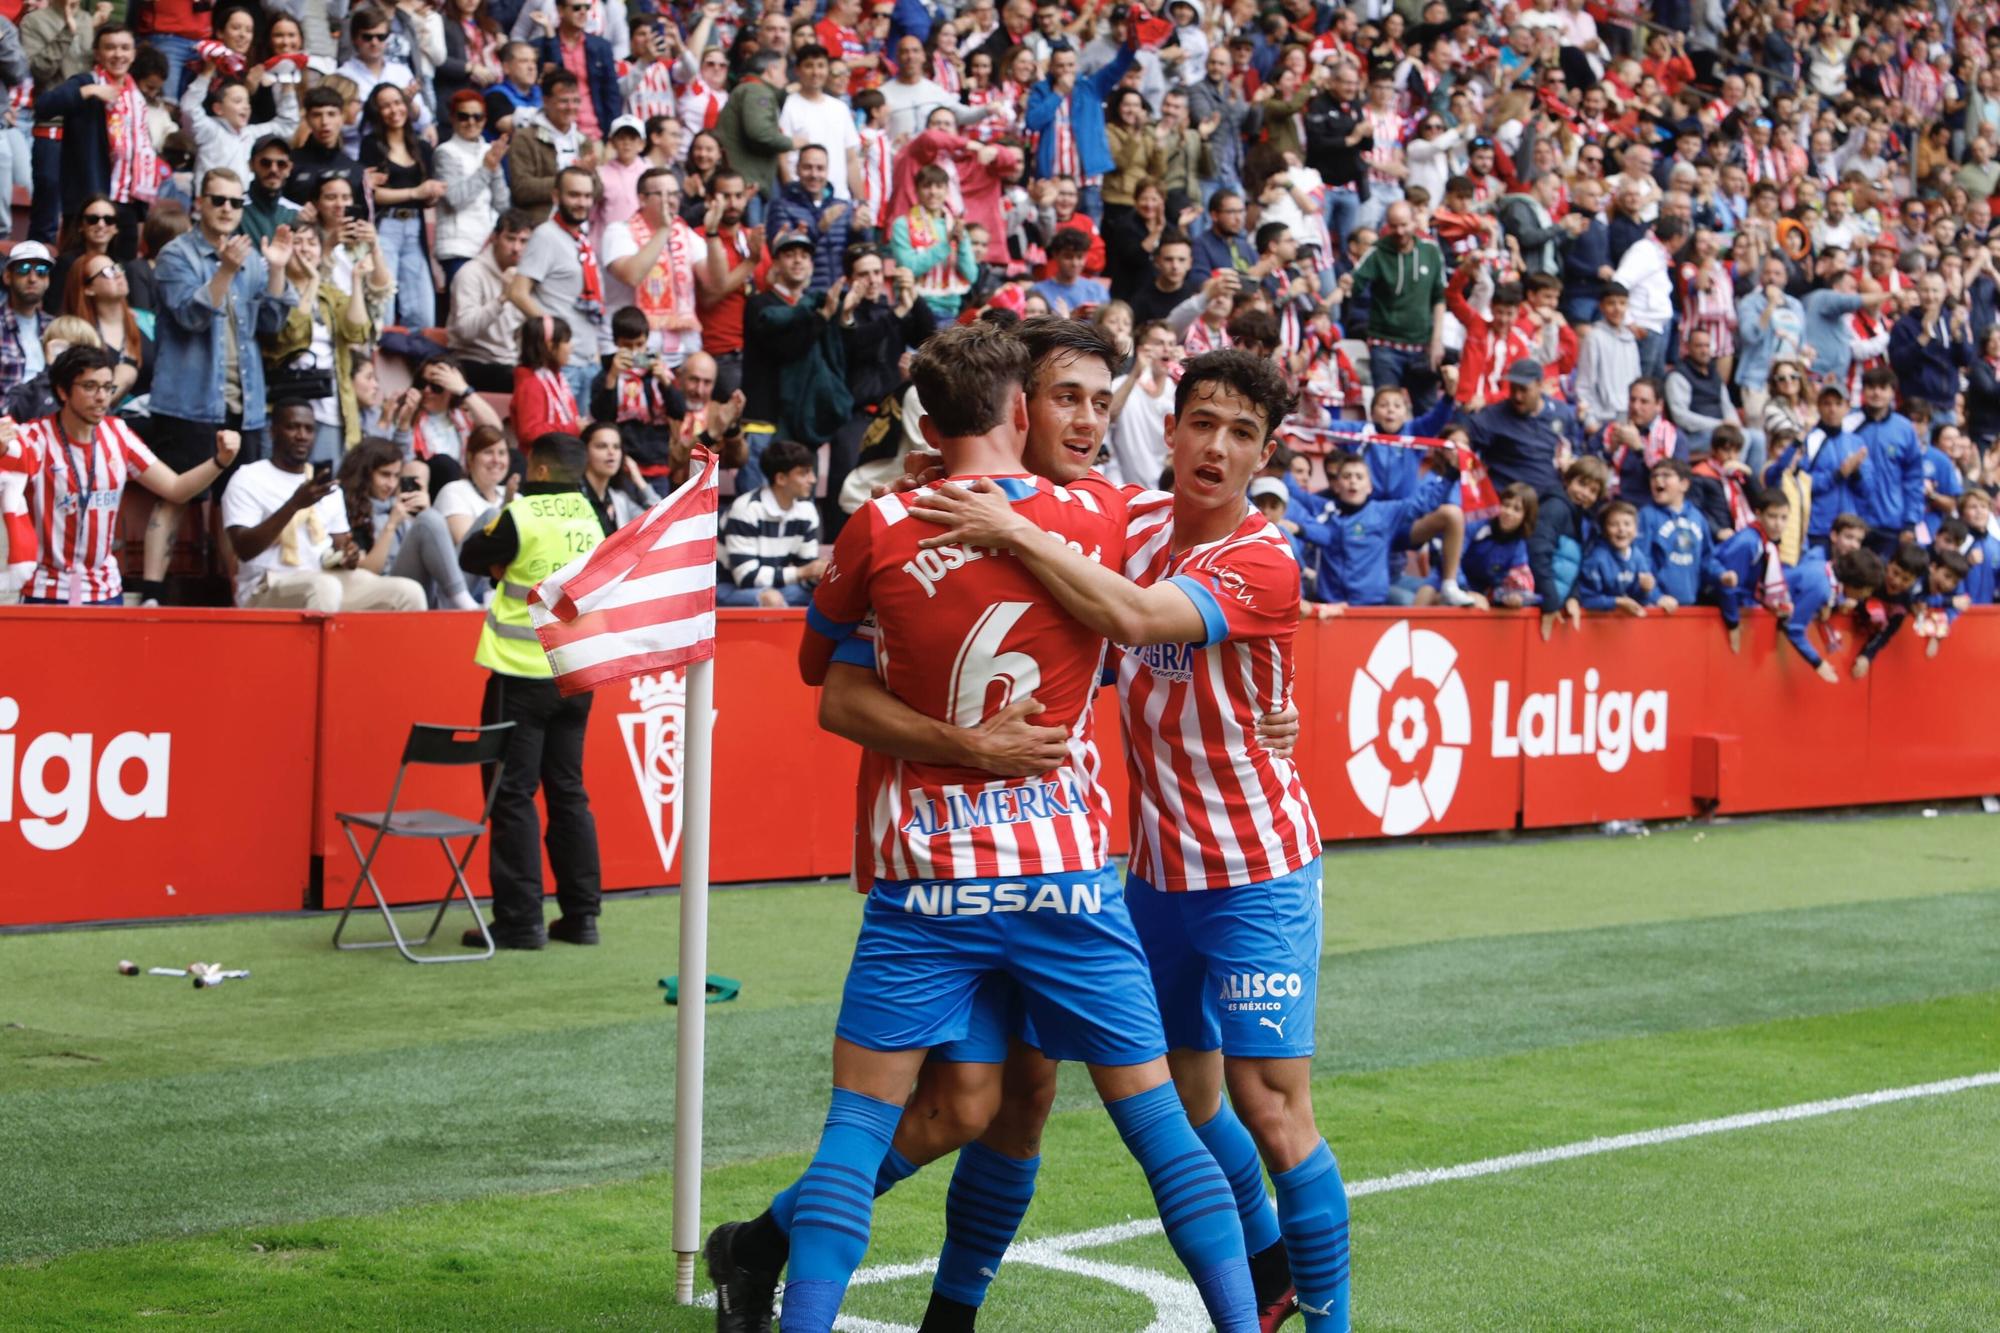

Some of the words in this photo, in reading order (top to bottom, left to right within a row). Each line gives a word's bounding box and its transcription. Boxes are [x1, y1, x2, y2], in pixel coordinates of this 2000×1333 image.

[946, 601, 1041, 728] 6
[1490, 667, 1668, 773] LaLiga
[903, 781, 1090, 835] ALIMERKA
[904, 883, 1101, 916] NISSAN
[1239, 1000, 1282, 1011] MÉXICO
